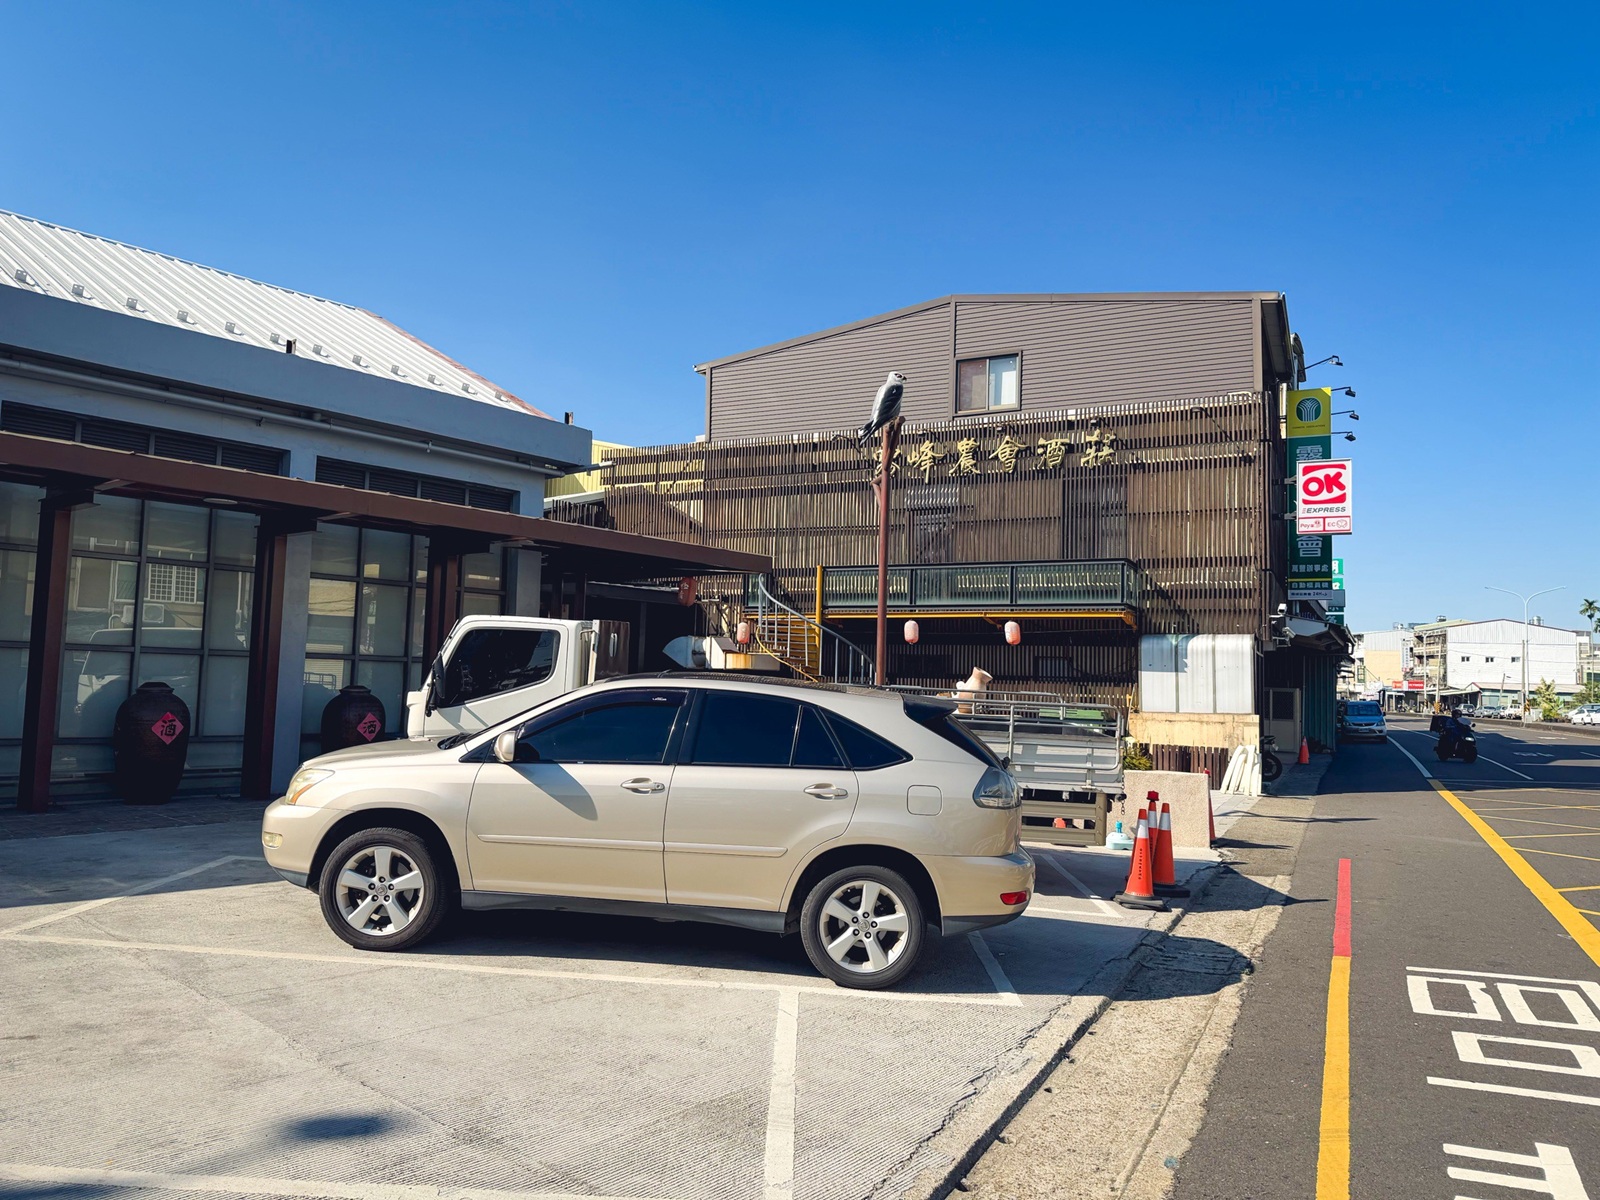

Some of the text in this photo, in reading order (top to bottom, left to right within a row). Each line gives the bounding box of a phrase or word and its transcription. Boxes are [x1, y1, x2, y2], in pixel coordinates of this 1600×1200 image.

[1302, 471, 1346, 497] OK
[1306, 506, 1346, 514] EXPRESS
[160, 718, 177, 737] 酒
[362, 720, 377, 735] 酒
